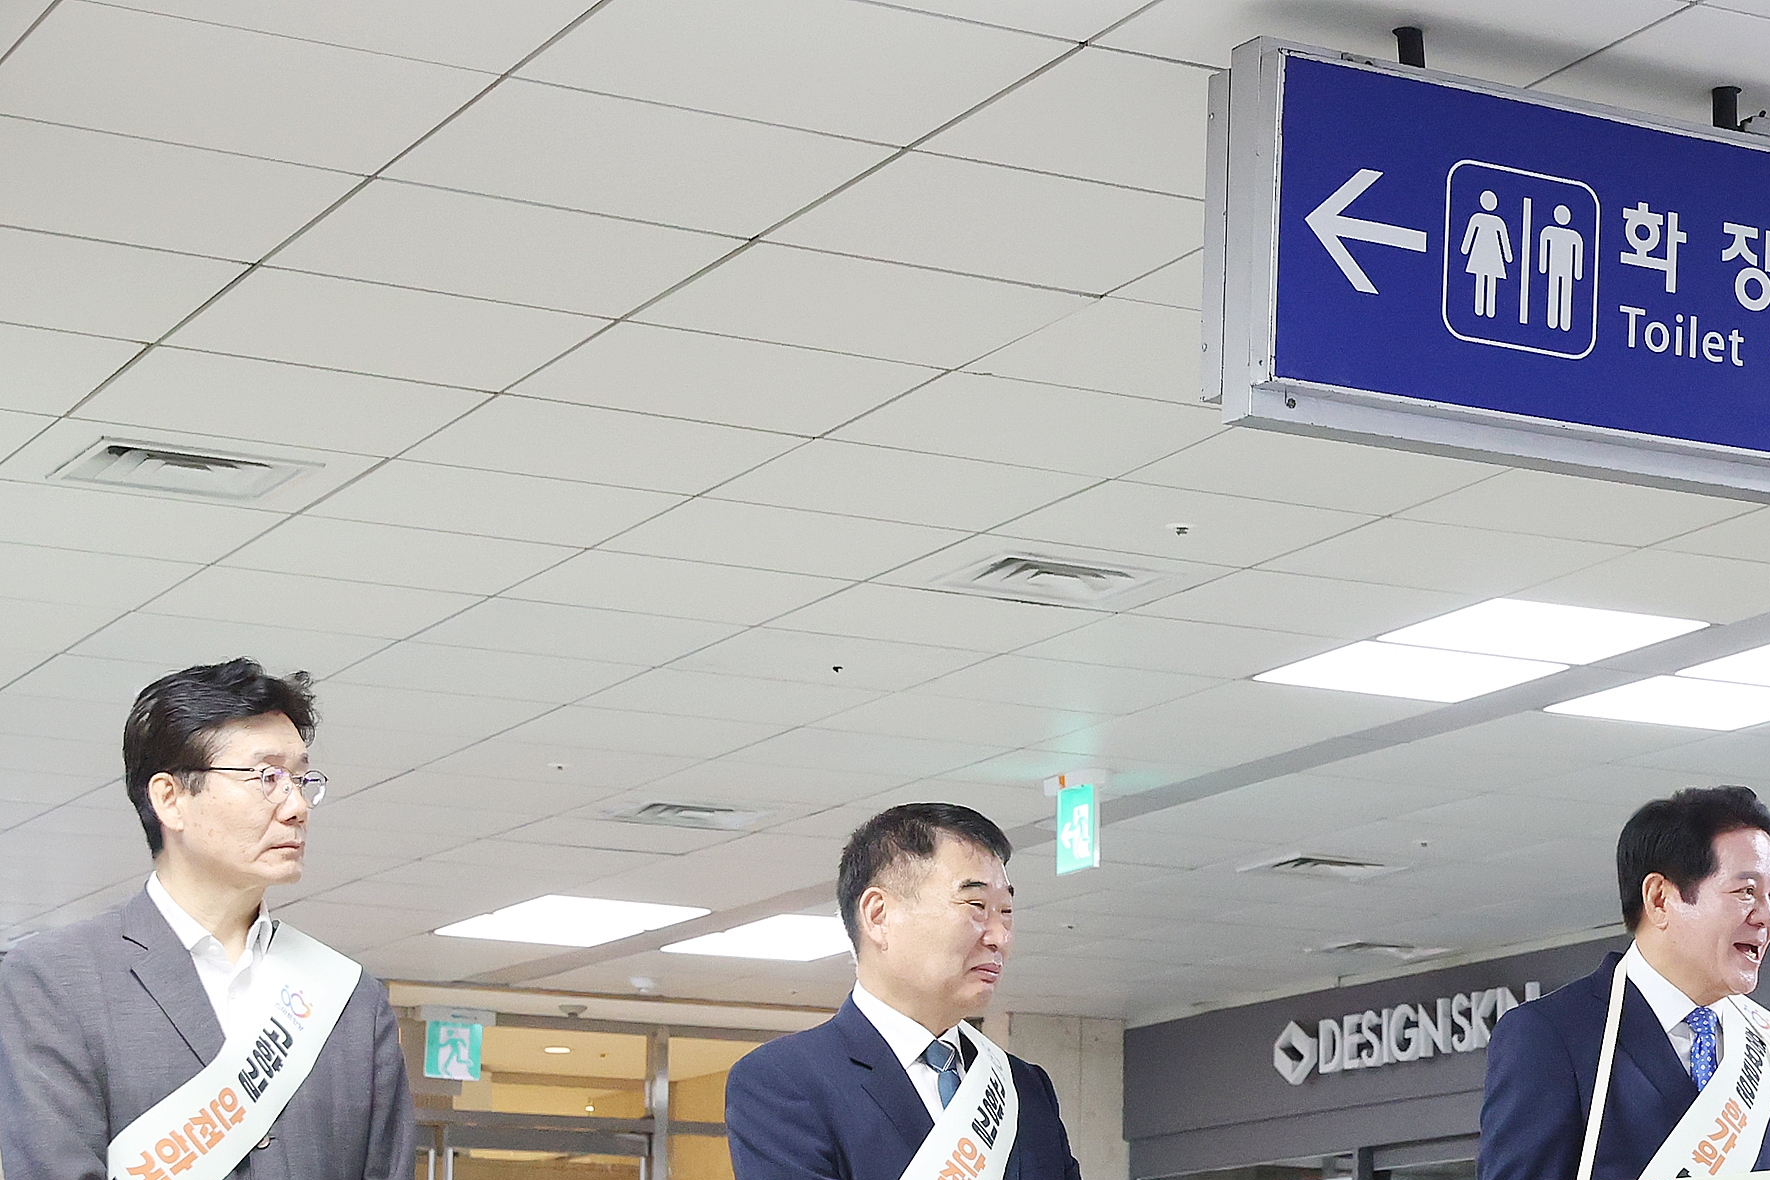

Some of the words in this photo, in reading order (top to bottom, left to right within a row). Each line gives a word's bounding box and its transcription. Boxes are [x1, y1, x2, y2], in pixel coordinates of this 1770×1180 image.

[1619, 305, 1744, 367] Toilet
[237, 1016, 296, 1104] 고향길
[972, 1068, 1009, 1150] 고향길
[1691, 1097, 1749, 1177] 한가위
